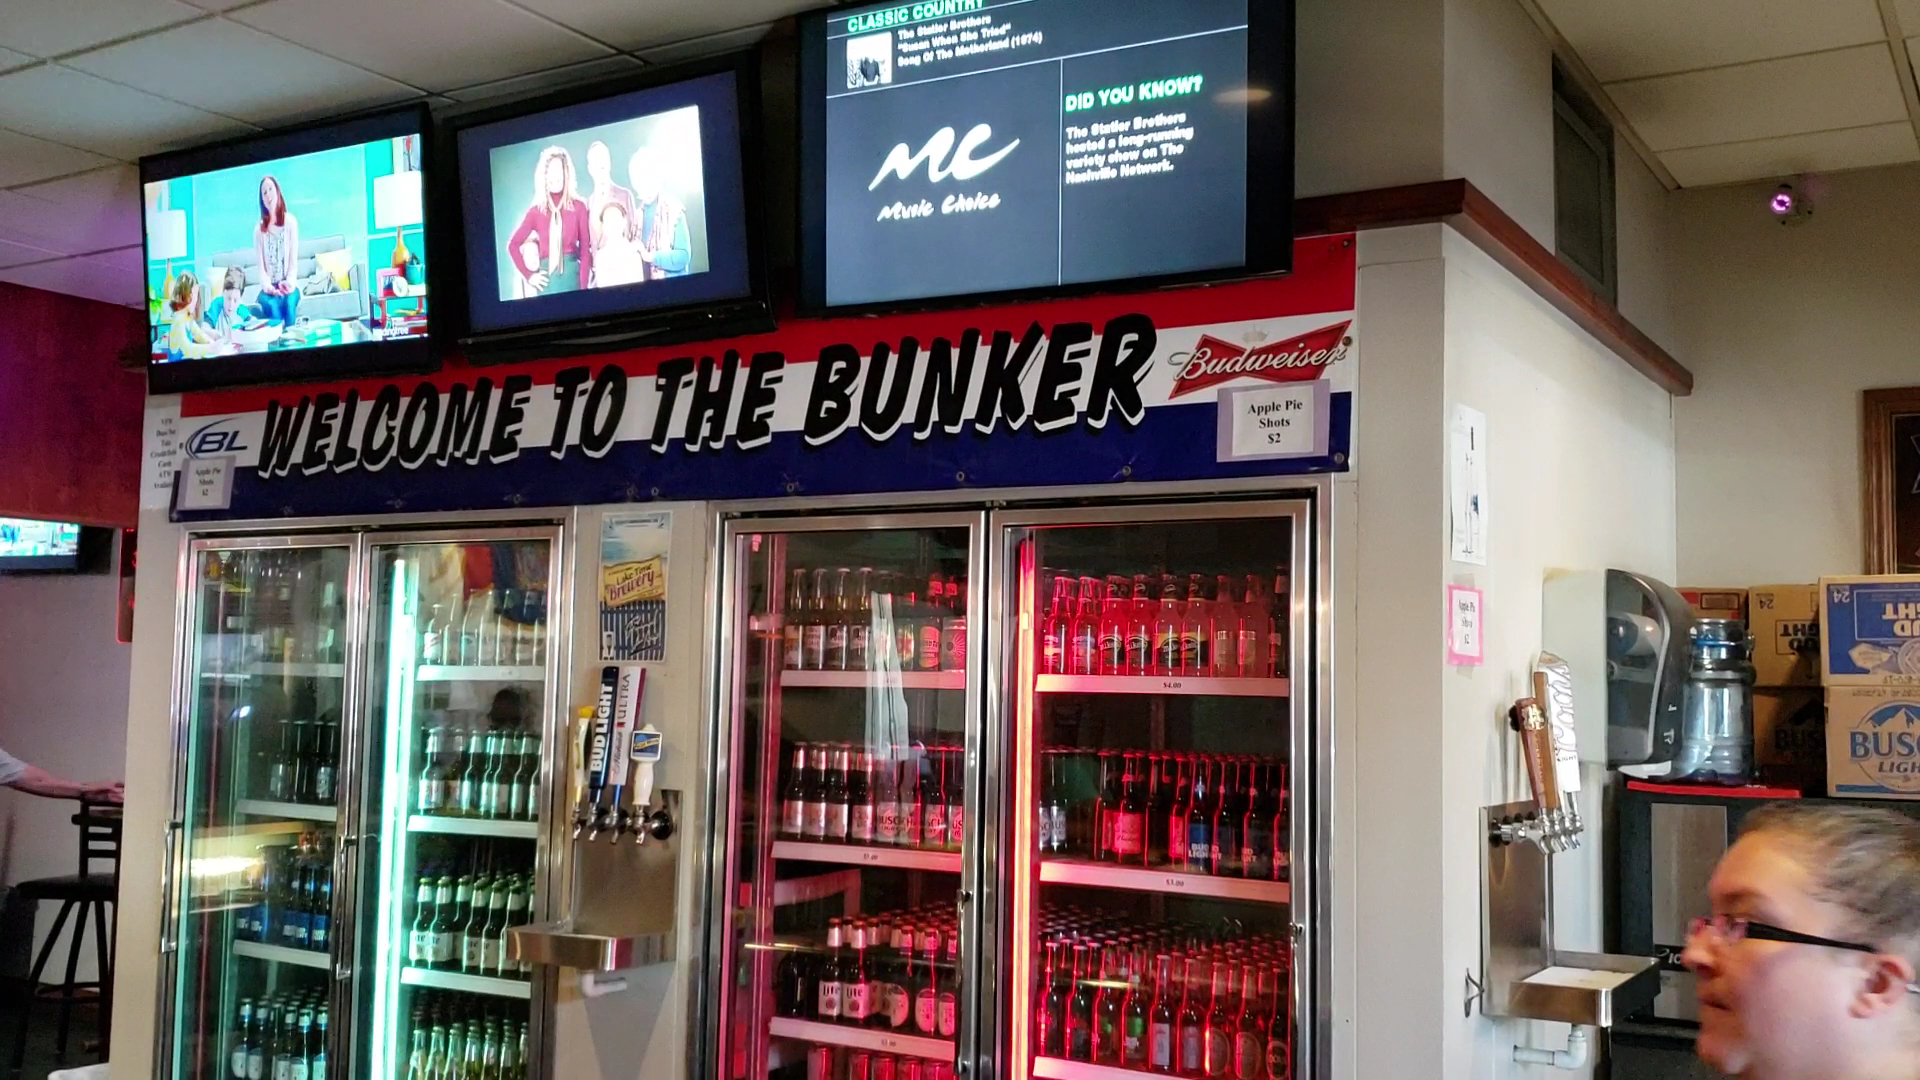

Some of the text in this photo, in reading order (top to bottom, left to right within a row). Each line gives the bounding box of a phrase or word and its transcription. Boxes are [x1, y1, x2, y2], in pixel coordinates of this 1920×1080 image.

[848, 0, 984, 33] CLASSIC COUNTRY
[898, 29, 915, 41] The
[950, 15, 991, 30] Brothers
[898, 55, 921, 68] Song
[923, 51, 935, 63] Of
[936, 46, 954, 60] The
[955, 37, 1010, 57] Motherland
[931, 35, 958, 49] When
[960, 30, 978, 43] She
[1065, 74, 1204, 112] DID YOU KNOW?
[1066, 126, 1088, 140] The
[1133, 112, 1187, 131] Brothers
[1066, 137, 1105, 155] hosted
[1108, 138, 1117, 149] a
[1066, 142, 1184, 170] variety show on The
[1066, 166, 1118, 184] Nashville
[877, 192, 1001, 222] Music Choice
[1168, 341, 1348, 382] Budweiser
[257, 313, 1158, 480] WELCOME TO THE BUNKER
[1248, 398, 1303, 416] Apple Pie
[1258, 416, 1291, 430] Shots
[1267, 432, 1281, 444] $2
[610, 570, 655, 601] Brewery
[1833, 590, 1850, 603] 24
[617, 673, 631, 719] ULTRA
[590, 683, 614, 771] BUD LIGHT
[1849, 731, 1920, 759] BUS
[1878, 762, 1920, 773] LIGH
